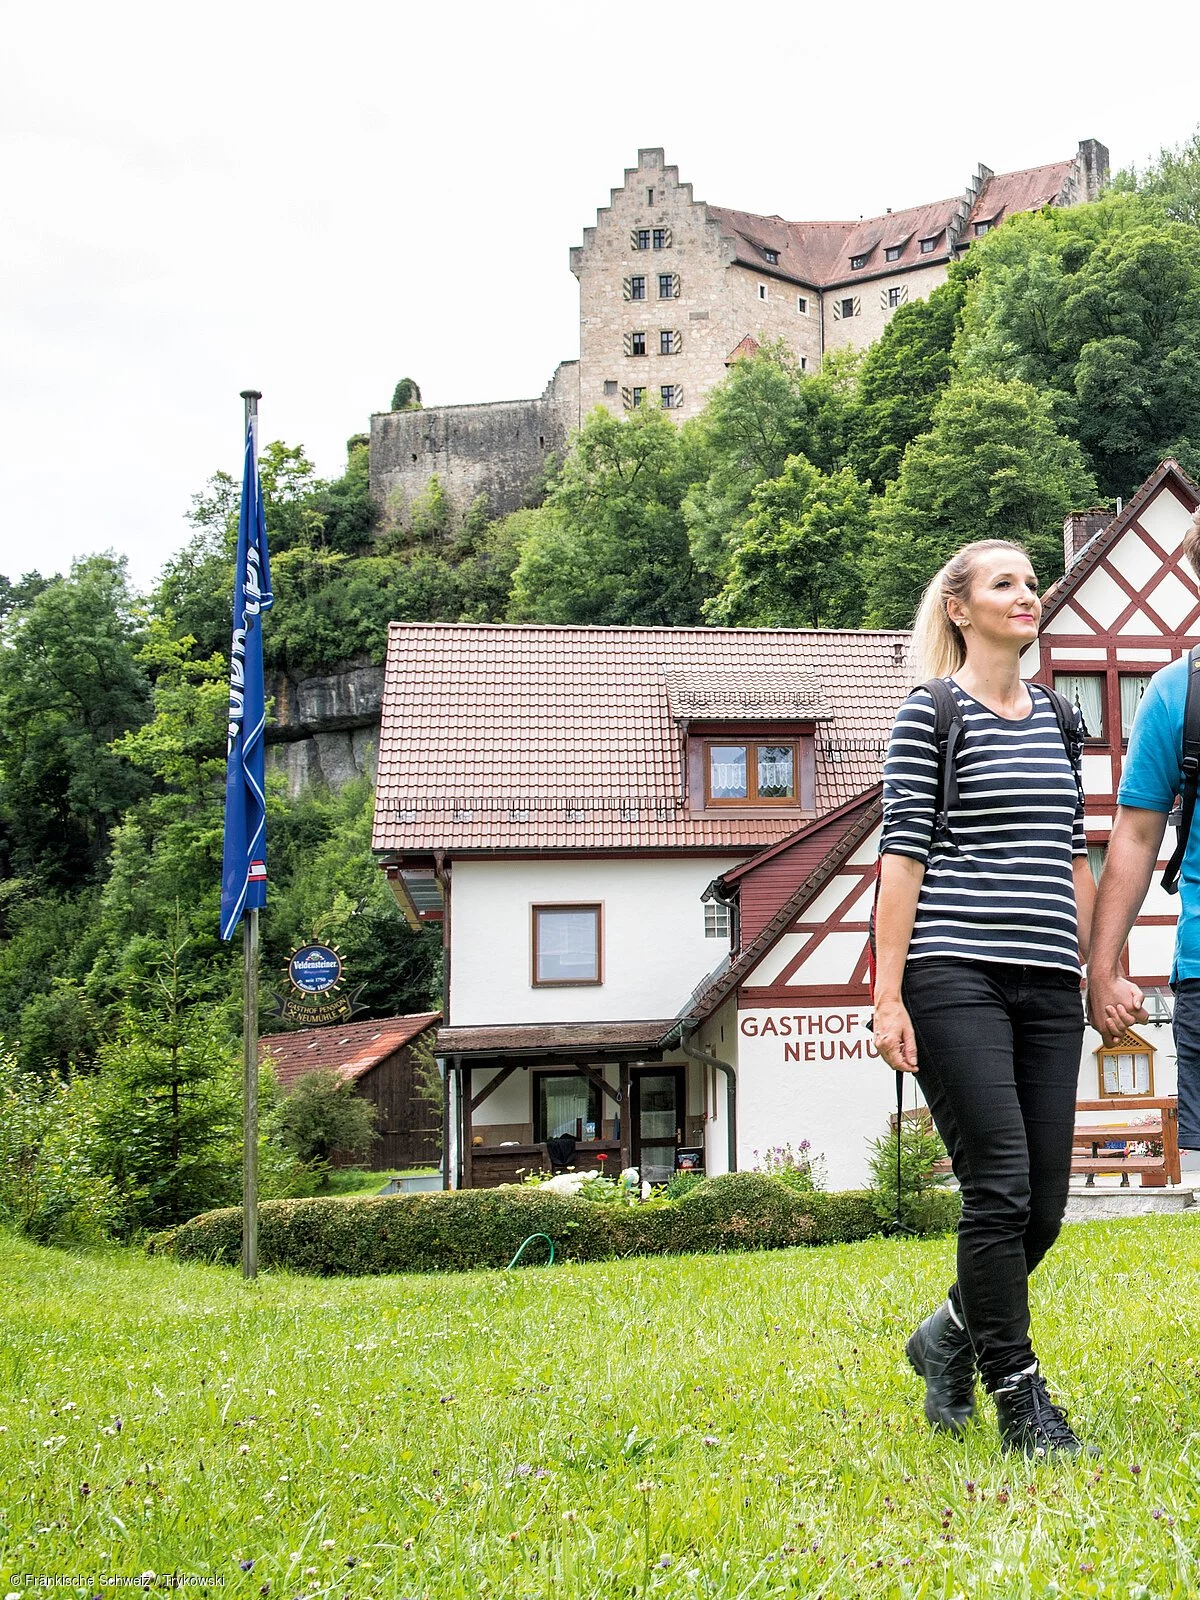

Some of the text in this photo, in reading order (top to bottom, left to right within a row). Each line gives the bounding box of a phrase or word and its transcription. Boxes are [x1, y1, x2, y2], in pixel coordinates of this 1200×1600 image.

[293, 960, 337, 970] Veldensteiner
[287, 998, 346, 1013] GASTHOF PENSION
[296, 1011, 337, 1022] NEUMÜHLE
[740, 1013, 859, 1037] GASTHOF
